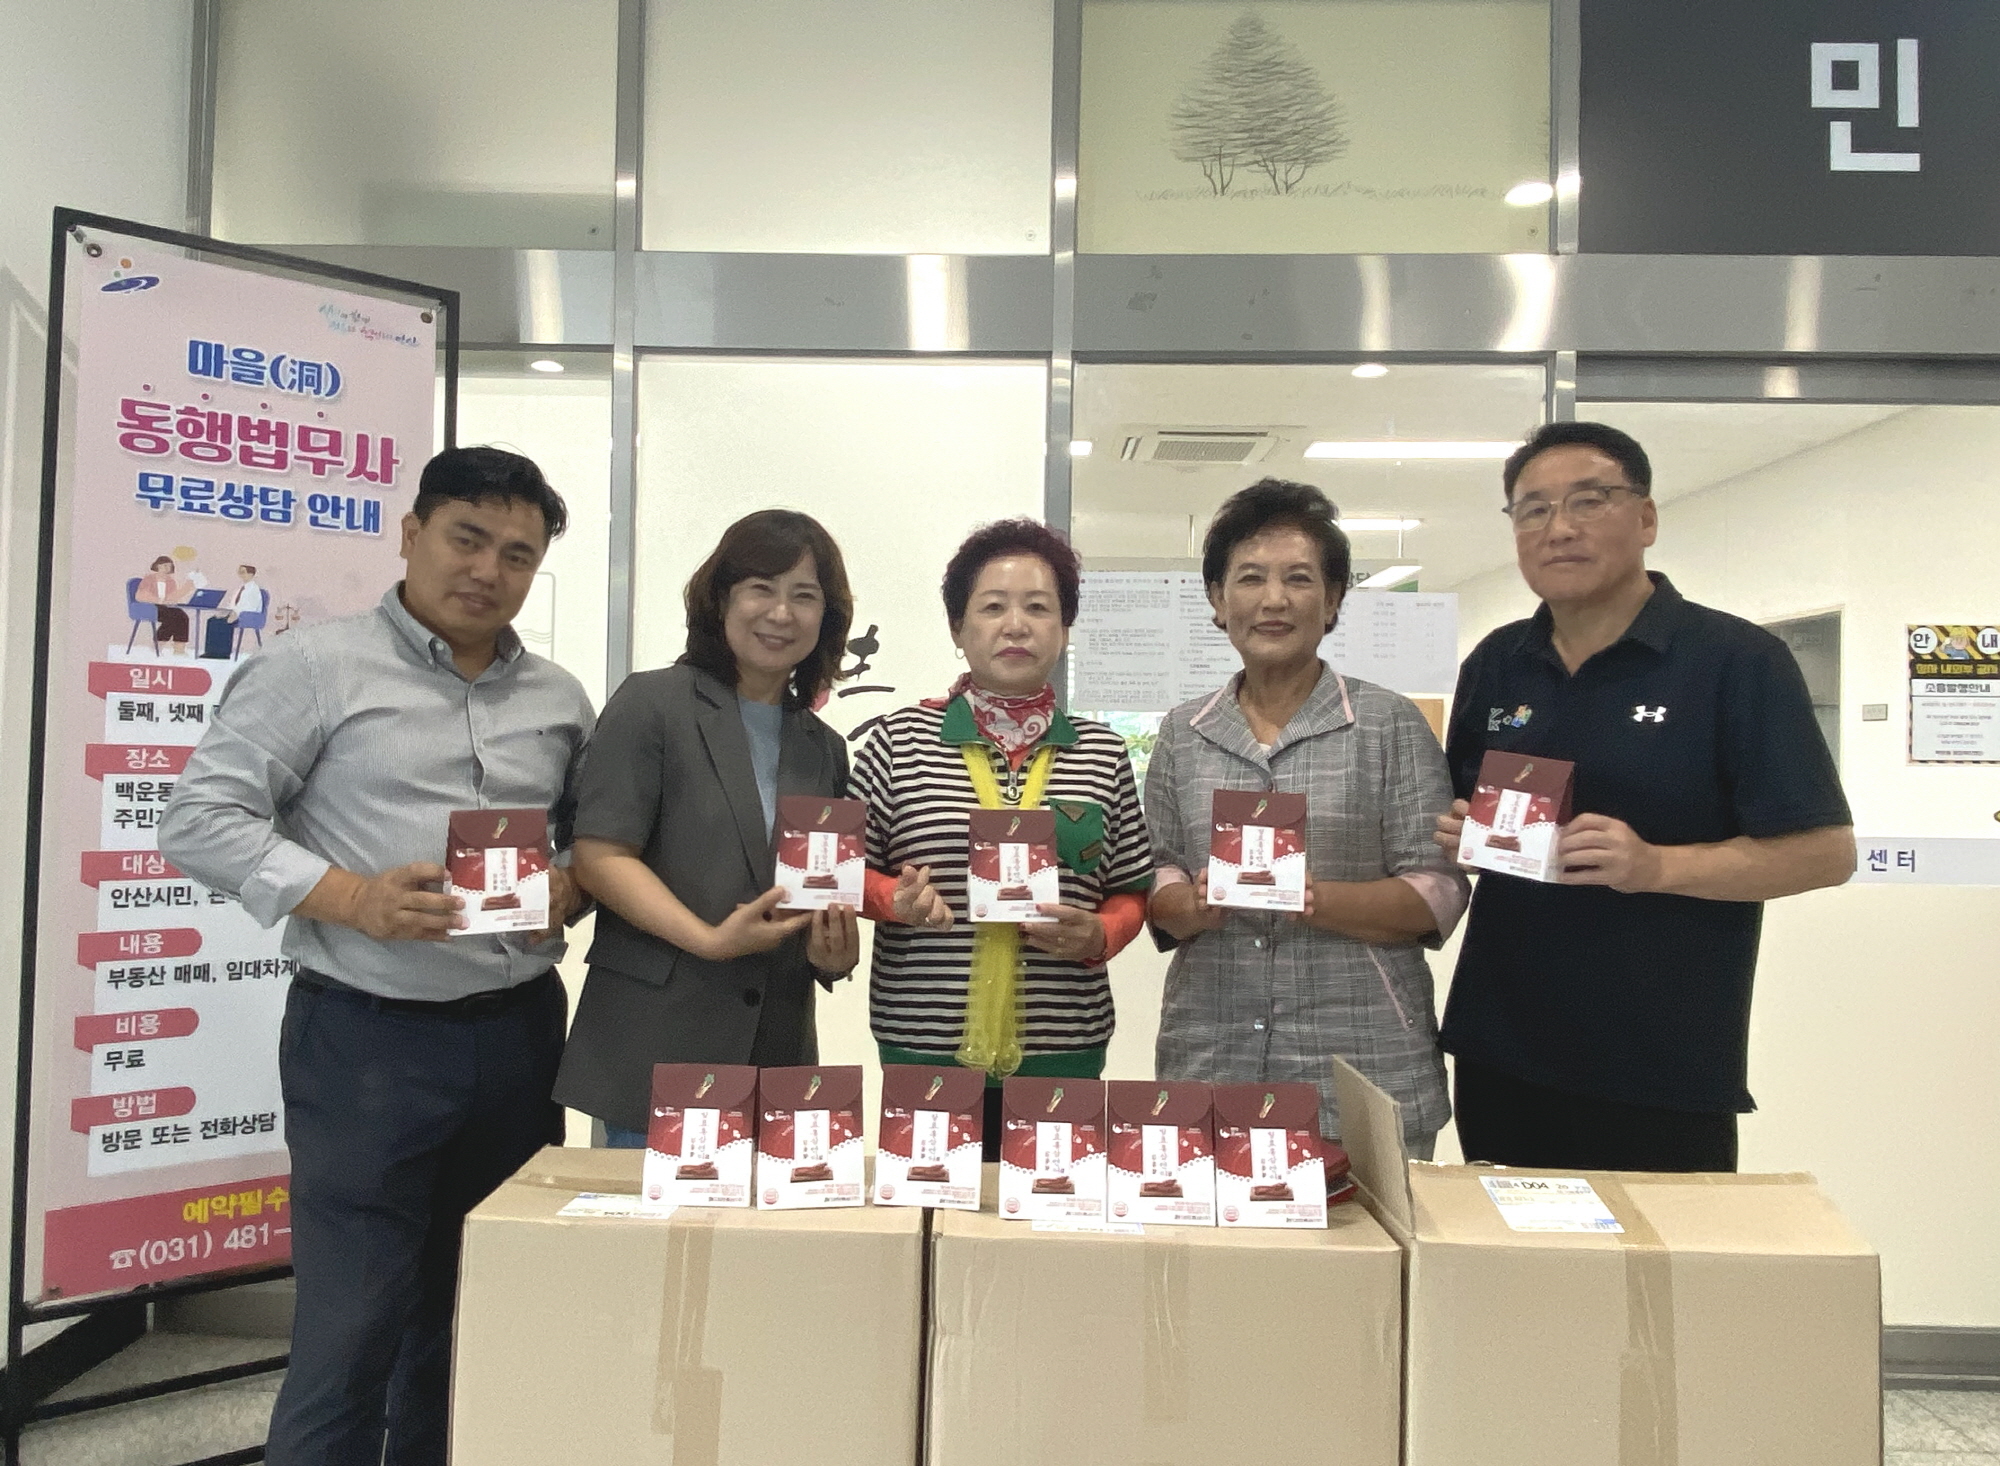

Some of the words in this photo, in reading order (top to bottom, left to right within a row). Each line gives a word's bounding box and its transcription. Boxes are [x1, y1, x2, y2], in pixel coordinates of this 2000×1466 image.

[1811, 38, 1920, 171] 민
[188, 340, 341, 397] 마을(洞)
[117, 398, 399, 484] 동행법무사
[135, 472, 296, 523] 무료상담
[307, 493, 381, 533] 안내
[129, 668, 173, 690] 일시
[117, 701, 159, 722] 둘째,
[169, 703, 204, 723] 넷째
[125, 748, 170, 769] 장소
[111, 886, 198, 908] 안산시민,
[119, 933, 164, 954] 내용
[107, 966, 166, 989] 부동산
[174, 963, 217, 983] 매매,
[116, 1013, 161, 1036] 비용
[104, 1049, 146, 1071] 무료
[113, 1092, 157, 1118] 방법
[102, 1129, 143, 1153] 방문
[151, 1124, 191, 1145] 또는
[200, 1112, 277, 1140] 전화상담
[183, 1186, 290, 1223] 예약필수
[140, 1230, 213, 1269] (031)
